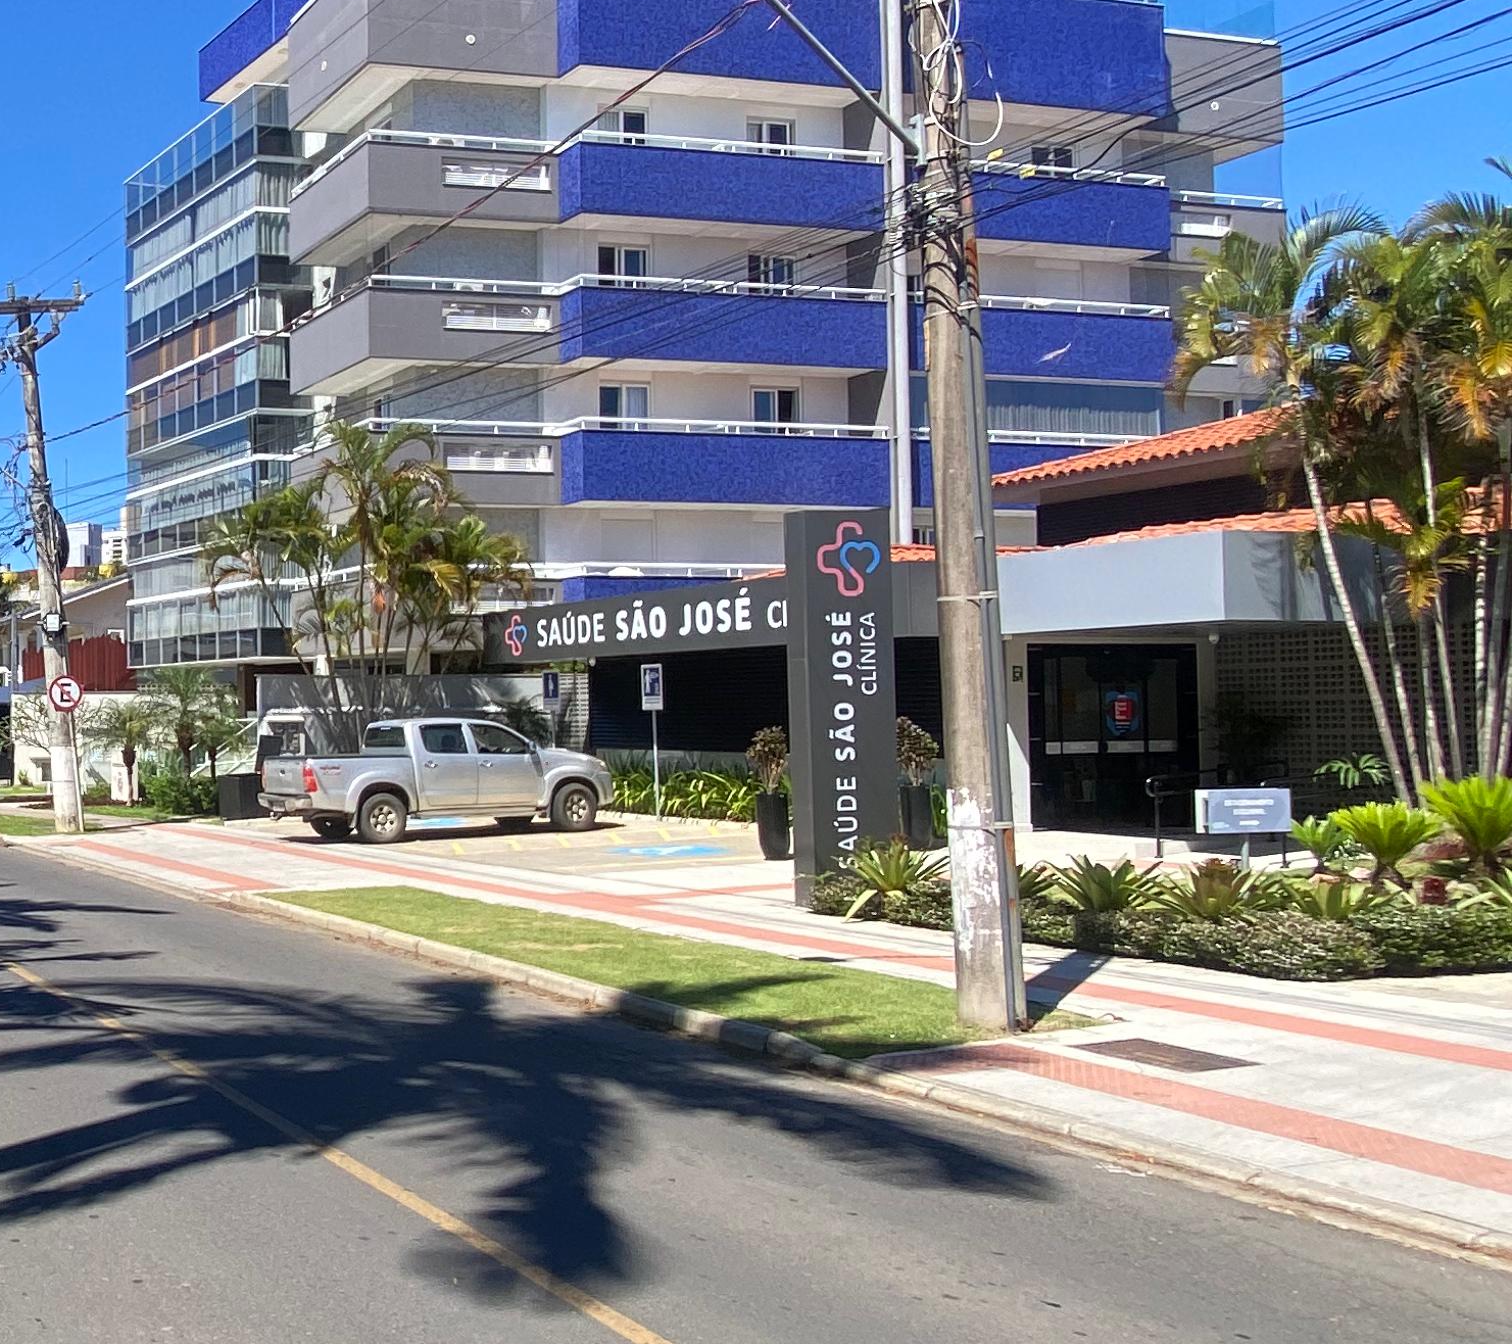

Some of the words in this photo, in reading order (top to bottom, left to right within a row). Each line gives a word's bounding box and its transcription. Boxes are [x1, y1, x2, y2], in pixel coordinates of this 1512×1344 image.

[537, 611, 606, 647] SAÚDE
[615, 600, 667, 642] SÃO
[678, 587, 752, 637] JOSÉ
[825, 611, 853, 687] JOSÉ
[856, 612, 877, 695] CLÍNICA
[60, 683, 72, 702] E
[828, 702, 856, 761] SÃO
[833, 776, 859, 869] SAÚDE
